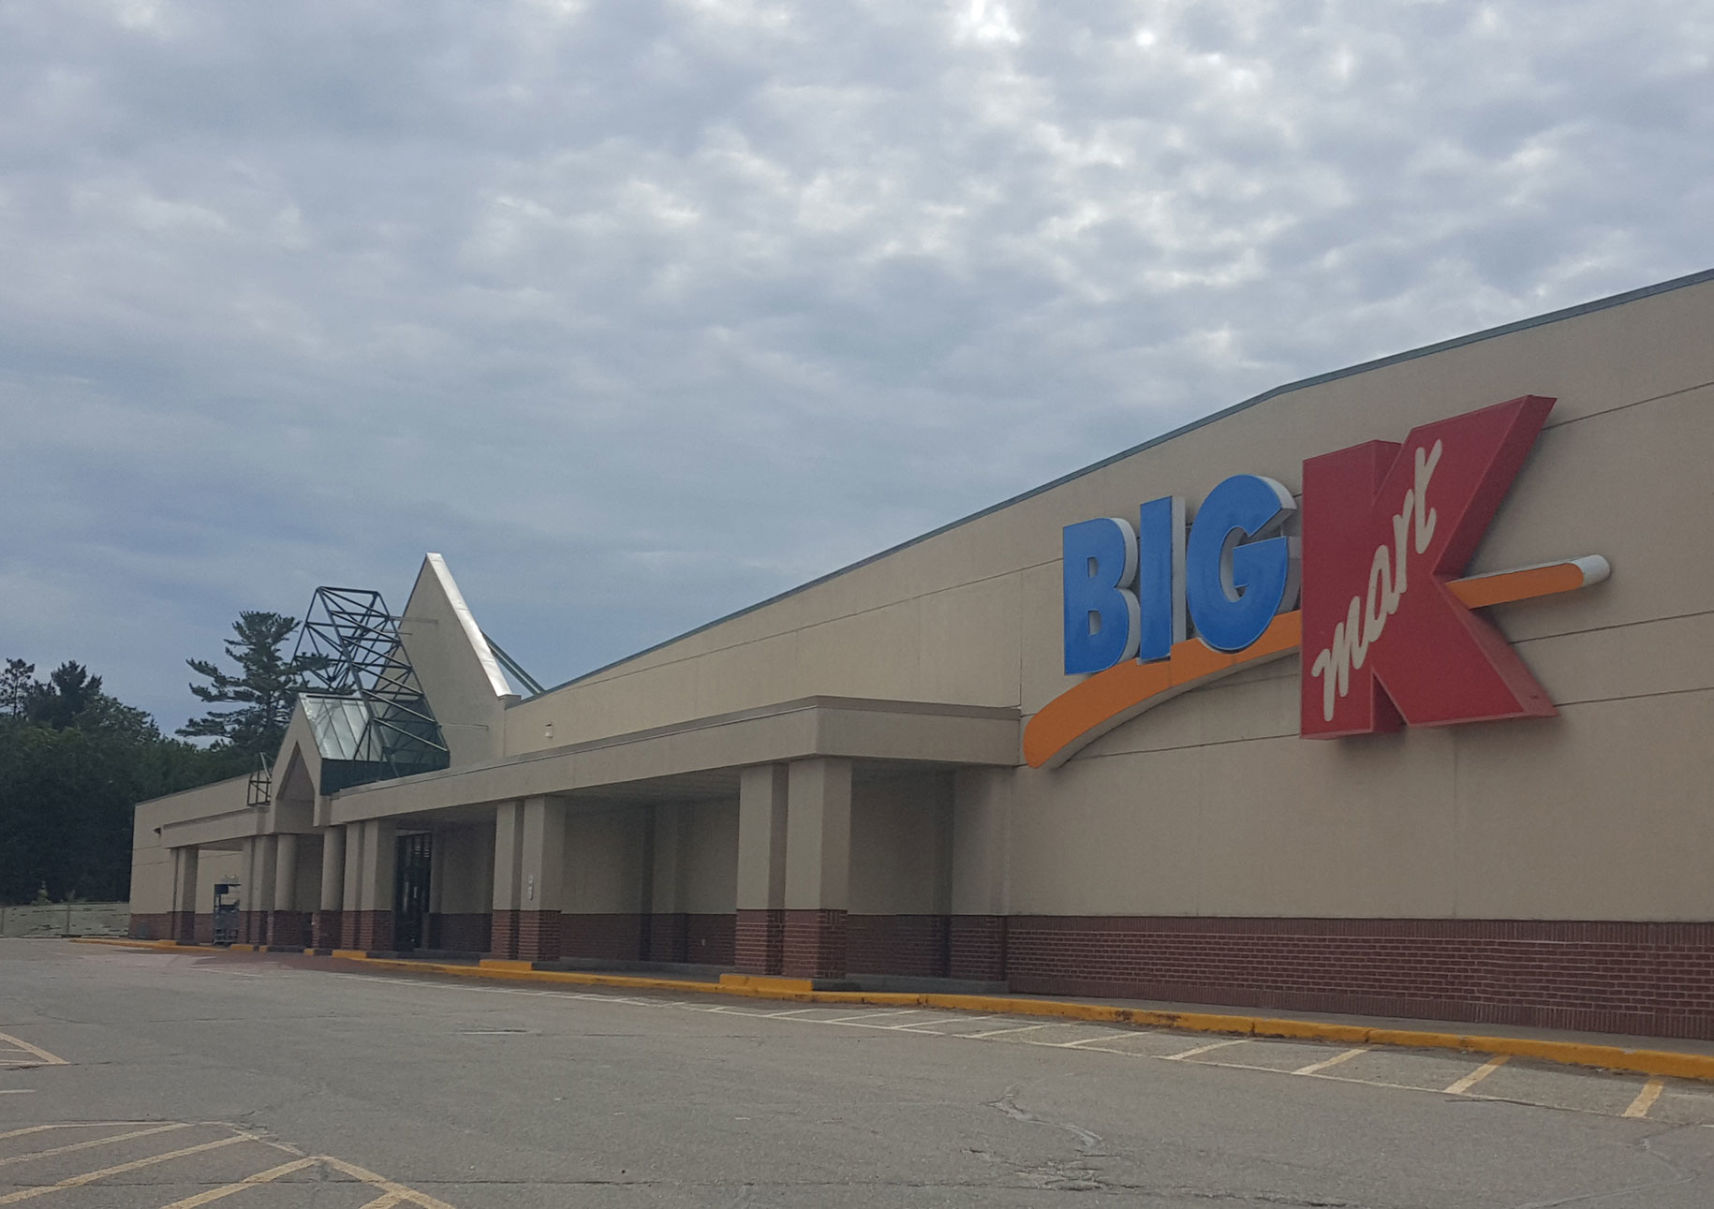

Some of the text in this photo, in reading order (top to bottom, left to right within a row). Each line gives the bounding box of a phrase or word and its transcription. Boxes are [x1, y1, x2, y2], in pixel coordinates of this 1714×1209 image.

[1063, 396, 1556, 740] BIG K
[1311, 438, 1443, 722] mart
